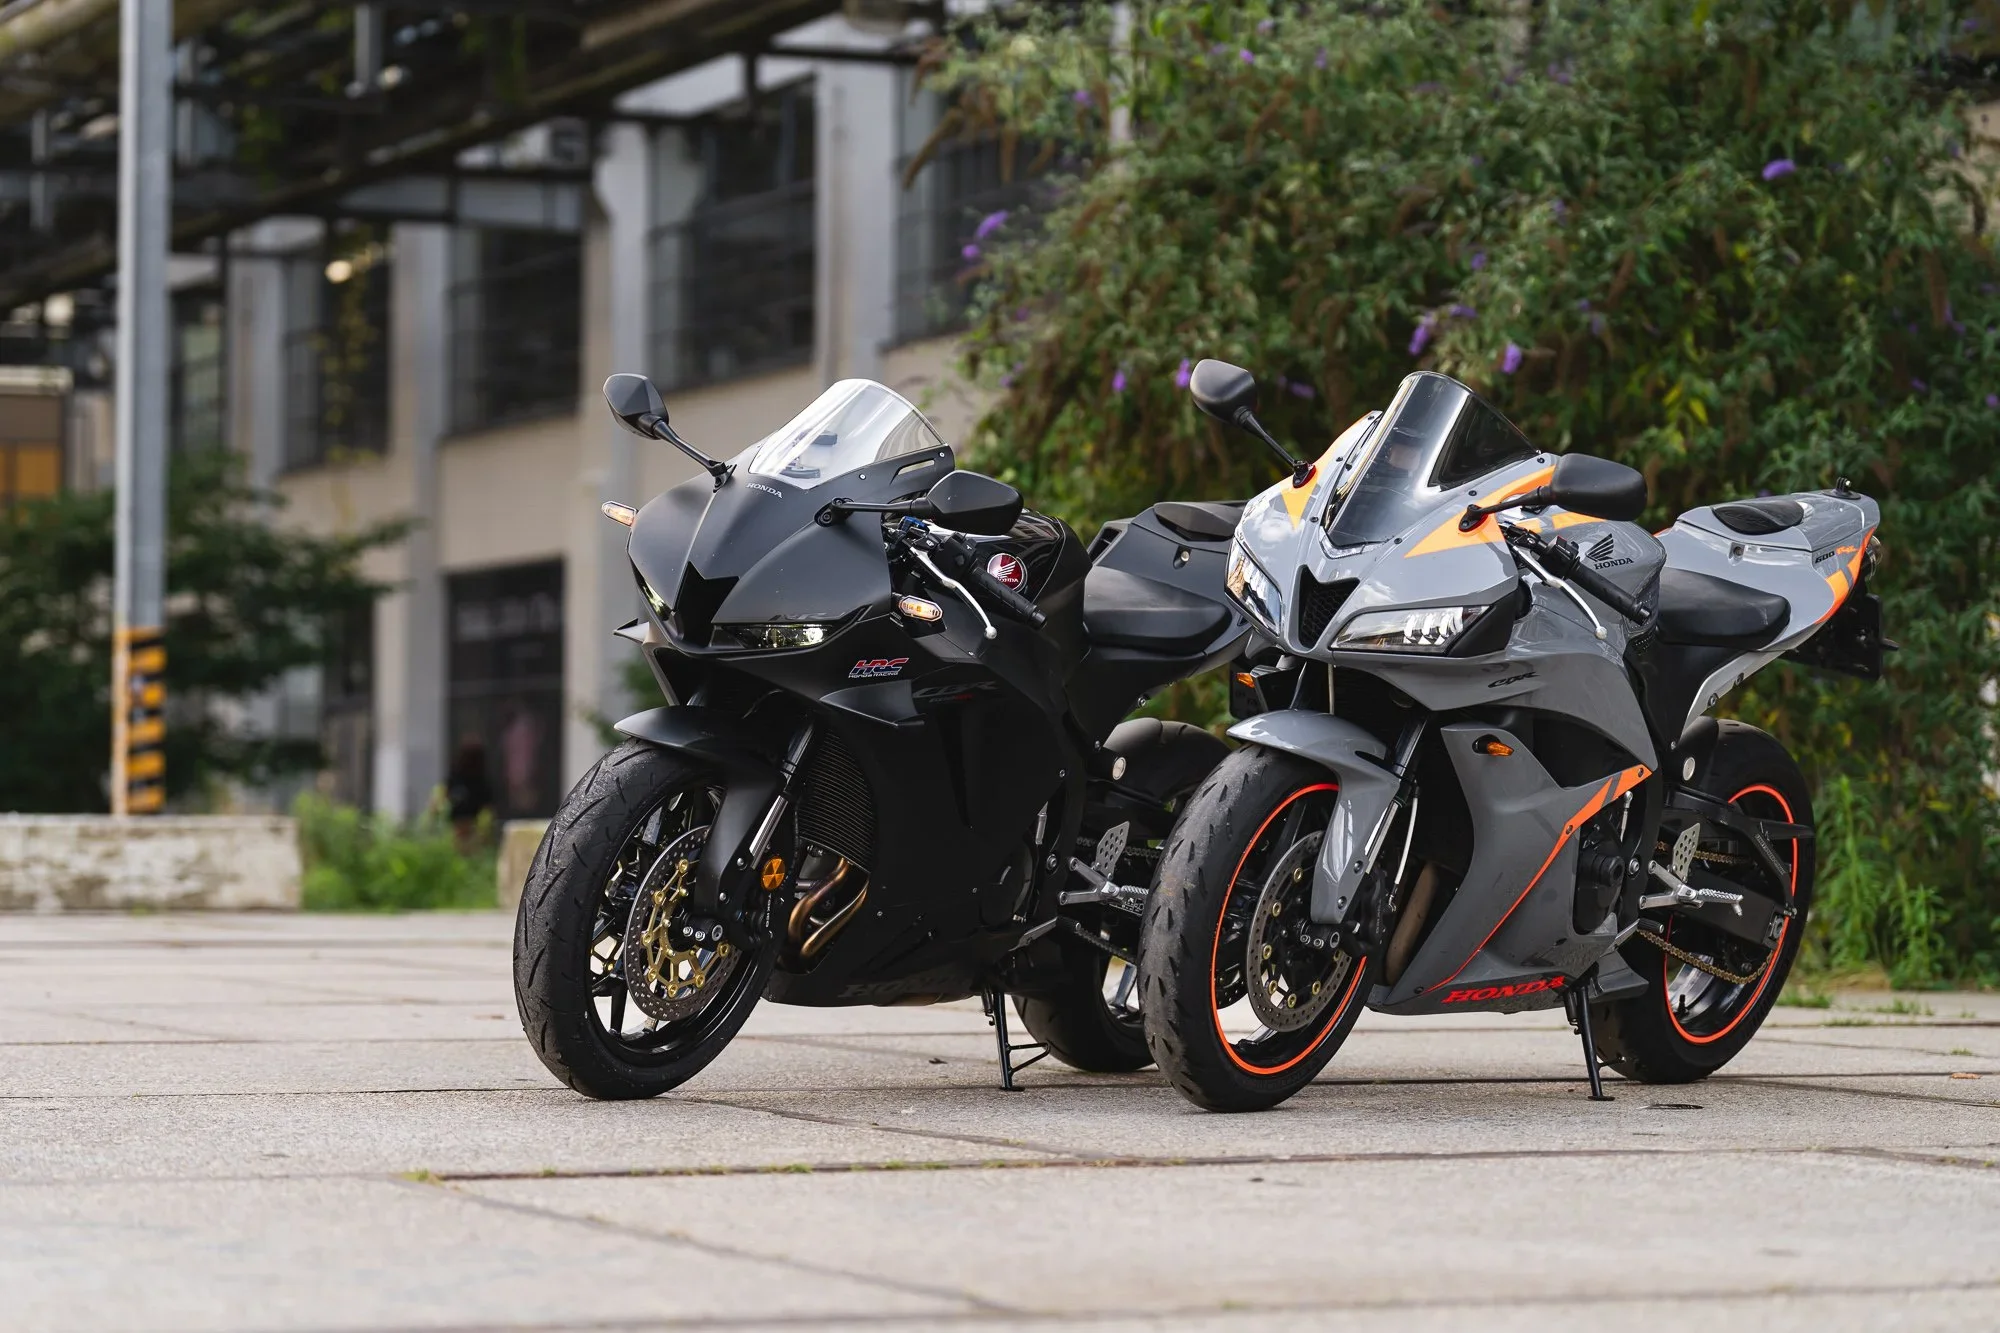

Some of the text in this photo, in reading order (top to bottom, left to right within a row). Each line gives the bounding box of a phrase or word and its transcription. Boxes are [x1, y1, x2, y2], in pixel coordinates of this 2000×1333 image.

[746, 482, 783, 499] HONDA
[1594, 557, 1634, 570] HONDA
[1815, 551, 1835, 564] 600
[849, 657, 910, 675] HRC
[1441, 975, 1565, 1004] HONDA
